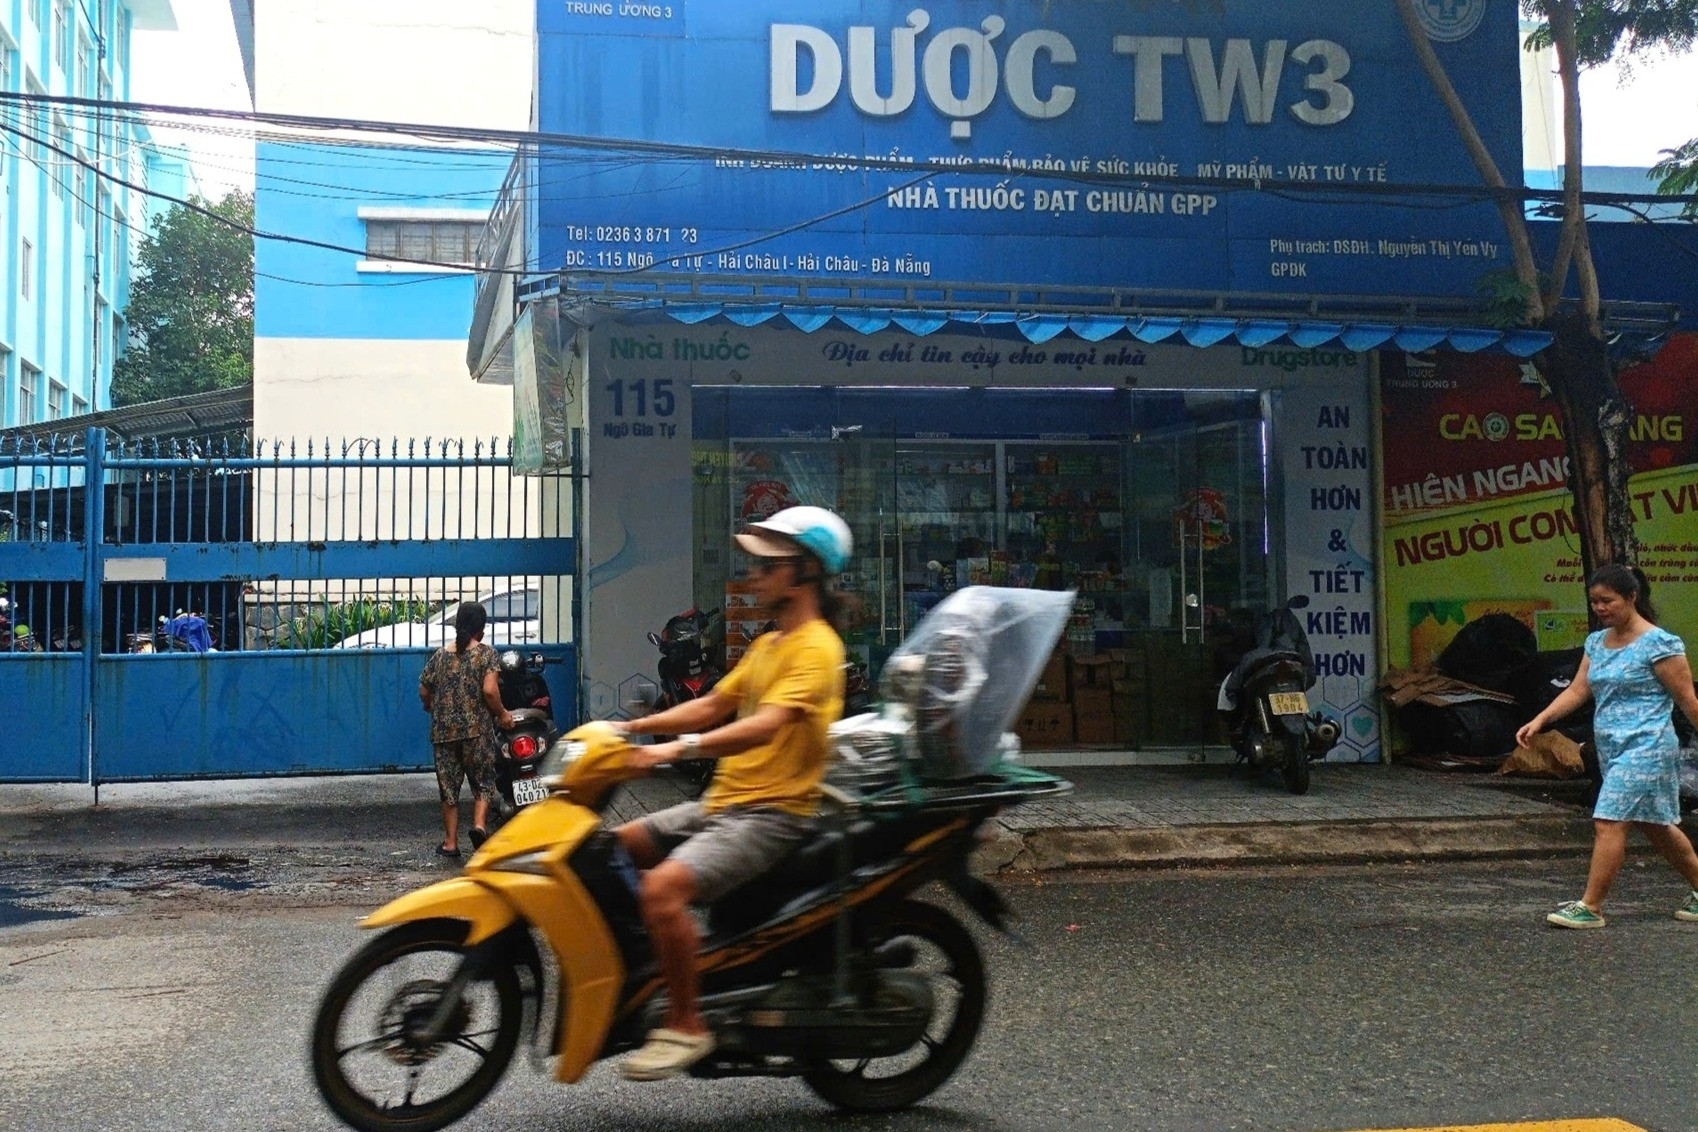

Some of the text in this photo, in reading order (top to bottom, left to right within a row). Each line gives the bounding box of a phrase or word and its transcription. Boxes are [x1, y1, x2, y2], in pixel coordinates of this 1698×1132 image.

[565, 1, 672, 18] TRUNG ƯƠNG 3
[770, 8, 1355, 140] DƯỢC TW3
[1096, 155, 1129, 174] SỨC
[1134, 155, 1179, 177] KHỎE
[1197, 160, 1221, 178] MỸ
[1225, 156, 1273, 180] PHẨM
[1323, 163, 1346, 181] TƯ
[1351, 166, 1362, 182] Y
[1366, 160, 1387, 183] TẾ
[888, 180, 1217, 217] NHÀ THUỐC ĐẠT CHUẨN GPP
[567, 225, 593, 241] Tel:
[597, 226, 630, 242] 0236
[634, 227, 642, 243] 3
[646, 227, 670, 243] 871
[1270, 239, 1293, 256] Phụ
[1430, 240, 1450, 259] Thị
[1480, 241, 1497, 258] Vy
[598, 251, 622, 267] 115
[718, 250, 741, 269] Hải
[745, 253, 779, 270] Châu
[798, 253, 820, 271] Hải
[825, 256, 858, 272] Châu
[872, 257, 889, 273] Đà
[895, 253, 931, 277] Nẵng
[610, 330, 750, 361] Nhà thuốc
[823, 341, 1146, 371] Địa chỉ tin cậy cho mọi nhà
[1242, 348, 1358, 373] Drugstore
[606, 378, 675, 417] 115
[1387, 379, 1419, 389] TRUNG
[1451, 380, 1458, 388] 3
[603, 421, 677, 439] Ngô Gia Tự
[1317, 406, 1350, 428] AN
[1515, 414, 1566, 442] SA
[1301, 441, 1367, 469] TOÀN
[1311, 484, 1361, 510] HƠN
[1391, 472, 1467, 511] HIÊN
[1328, 529, 1347, 552] &
[1394, 518, 1504, 567] NGƯỜI
[1508, 508, 1580, 547] CON
[1309, 562, 1365, 593] TIẾT
[1544, 573, 1556, 582] Có
[1307, 606, 1371, 639] KIỆM
[1315, 650, 1365, 677] HƠN
